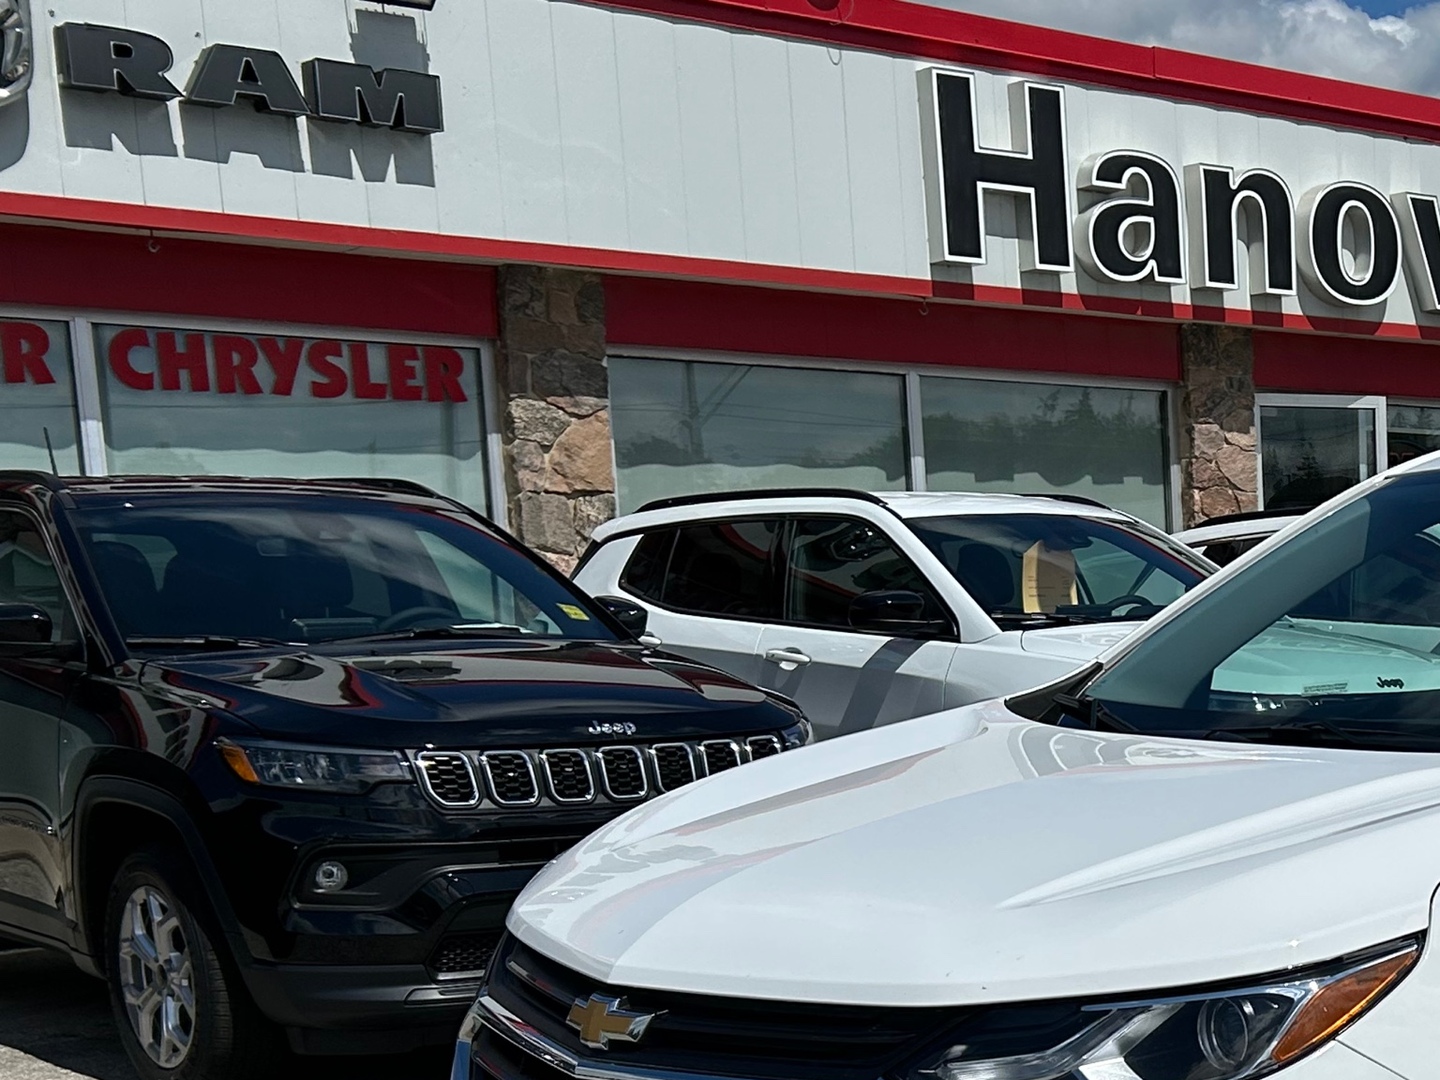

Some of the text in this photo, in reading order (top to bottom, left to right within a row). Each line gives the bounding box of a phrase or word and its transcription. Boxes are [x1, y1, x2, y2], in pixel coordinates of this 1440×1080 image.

[55, 20, 443, 134] RAM
[108, 327, 469, 404] CHRYSLER
[1376, 676, 1405, 690] Jeep
[587, 719, 637, 736] Jeep
